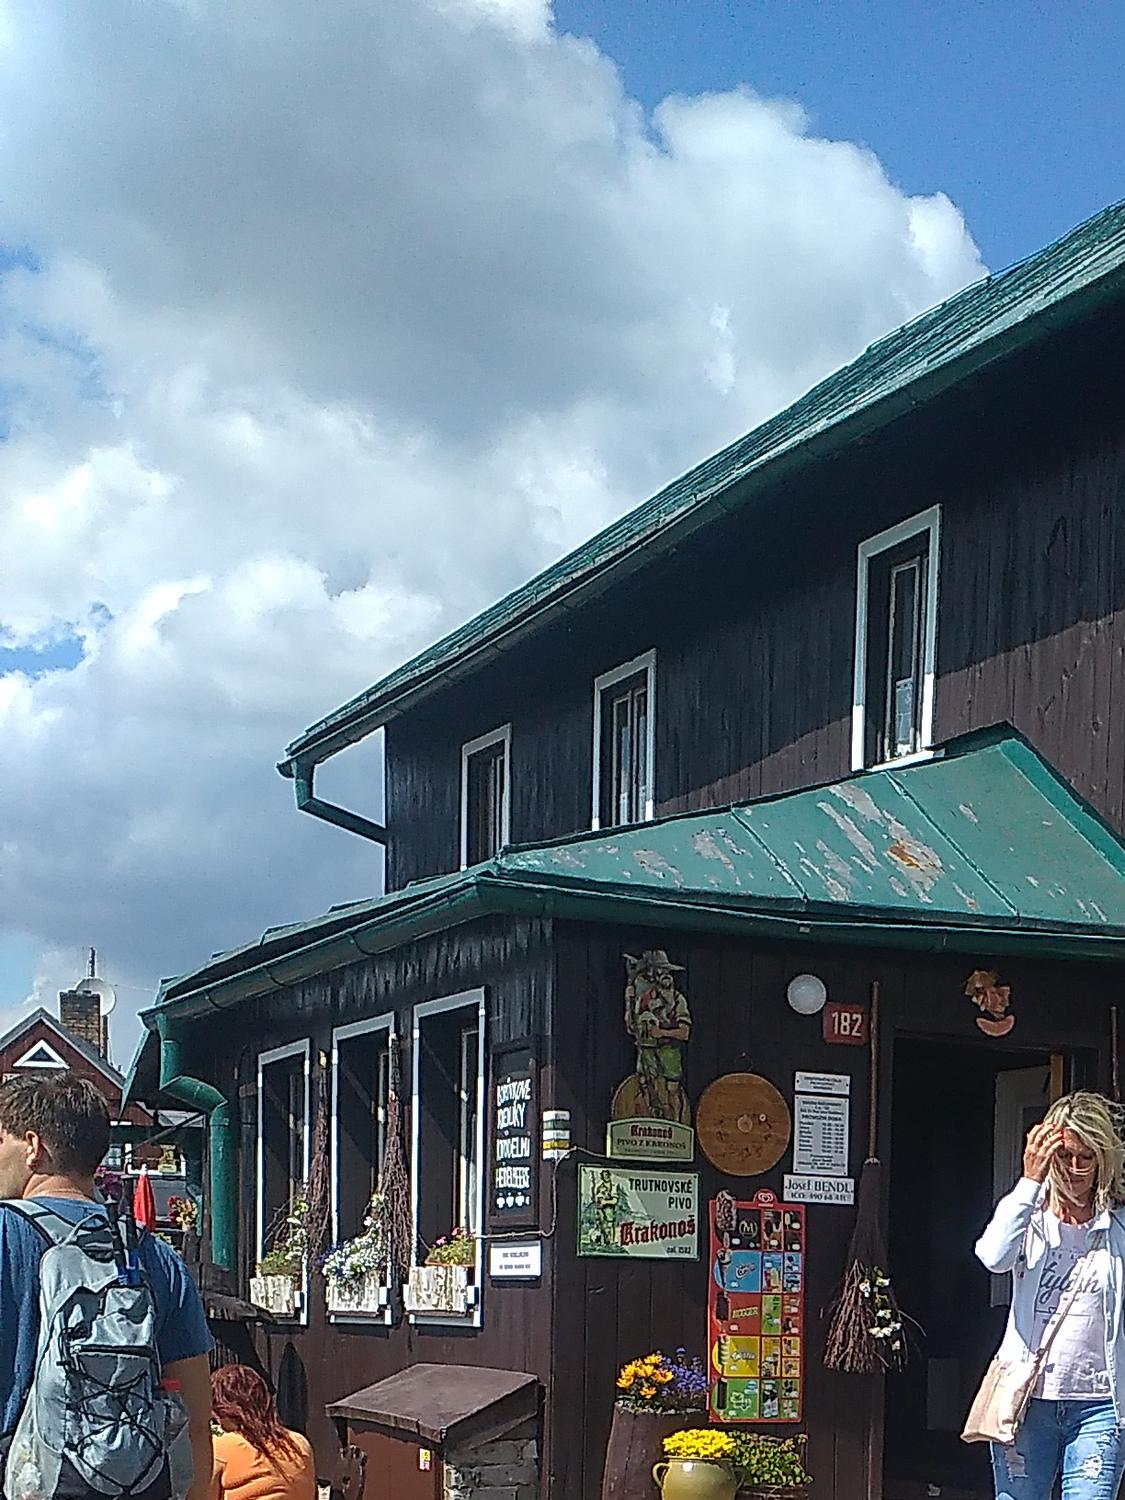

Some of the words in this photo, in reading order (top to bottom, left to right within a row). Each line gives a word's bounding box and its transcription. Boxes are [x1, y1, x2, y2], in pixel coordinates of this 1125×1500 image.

[832, 1011, 862, 1037] 182
[628, 1178, 693, 1194] TRUTNOVSKÉ
[668, 1196, 692, 1209] PIVO
[620, 1215, 696, 1246] Krakonoš
